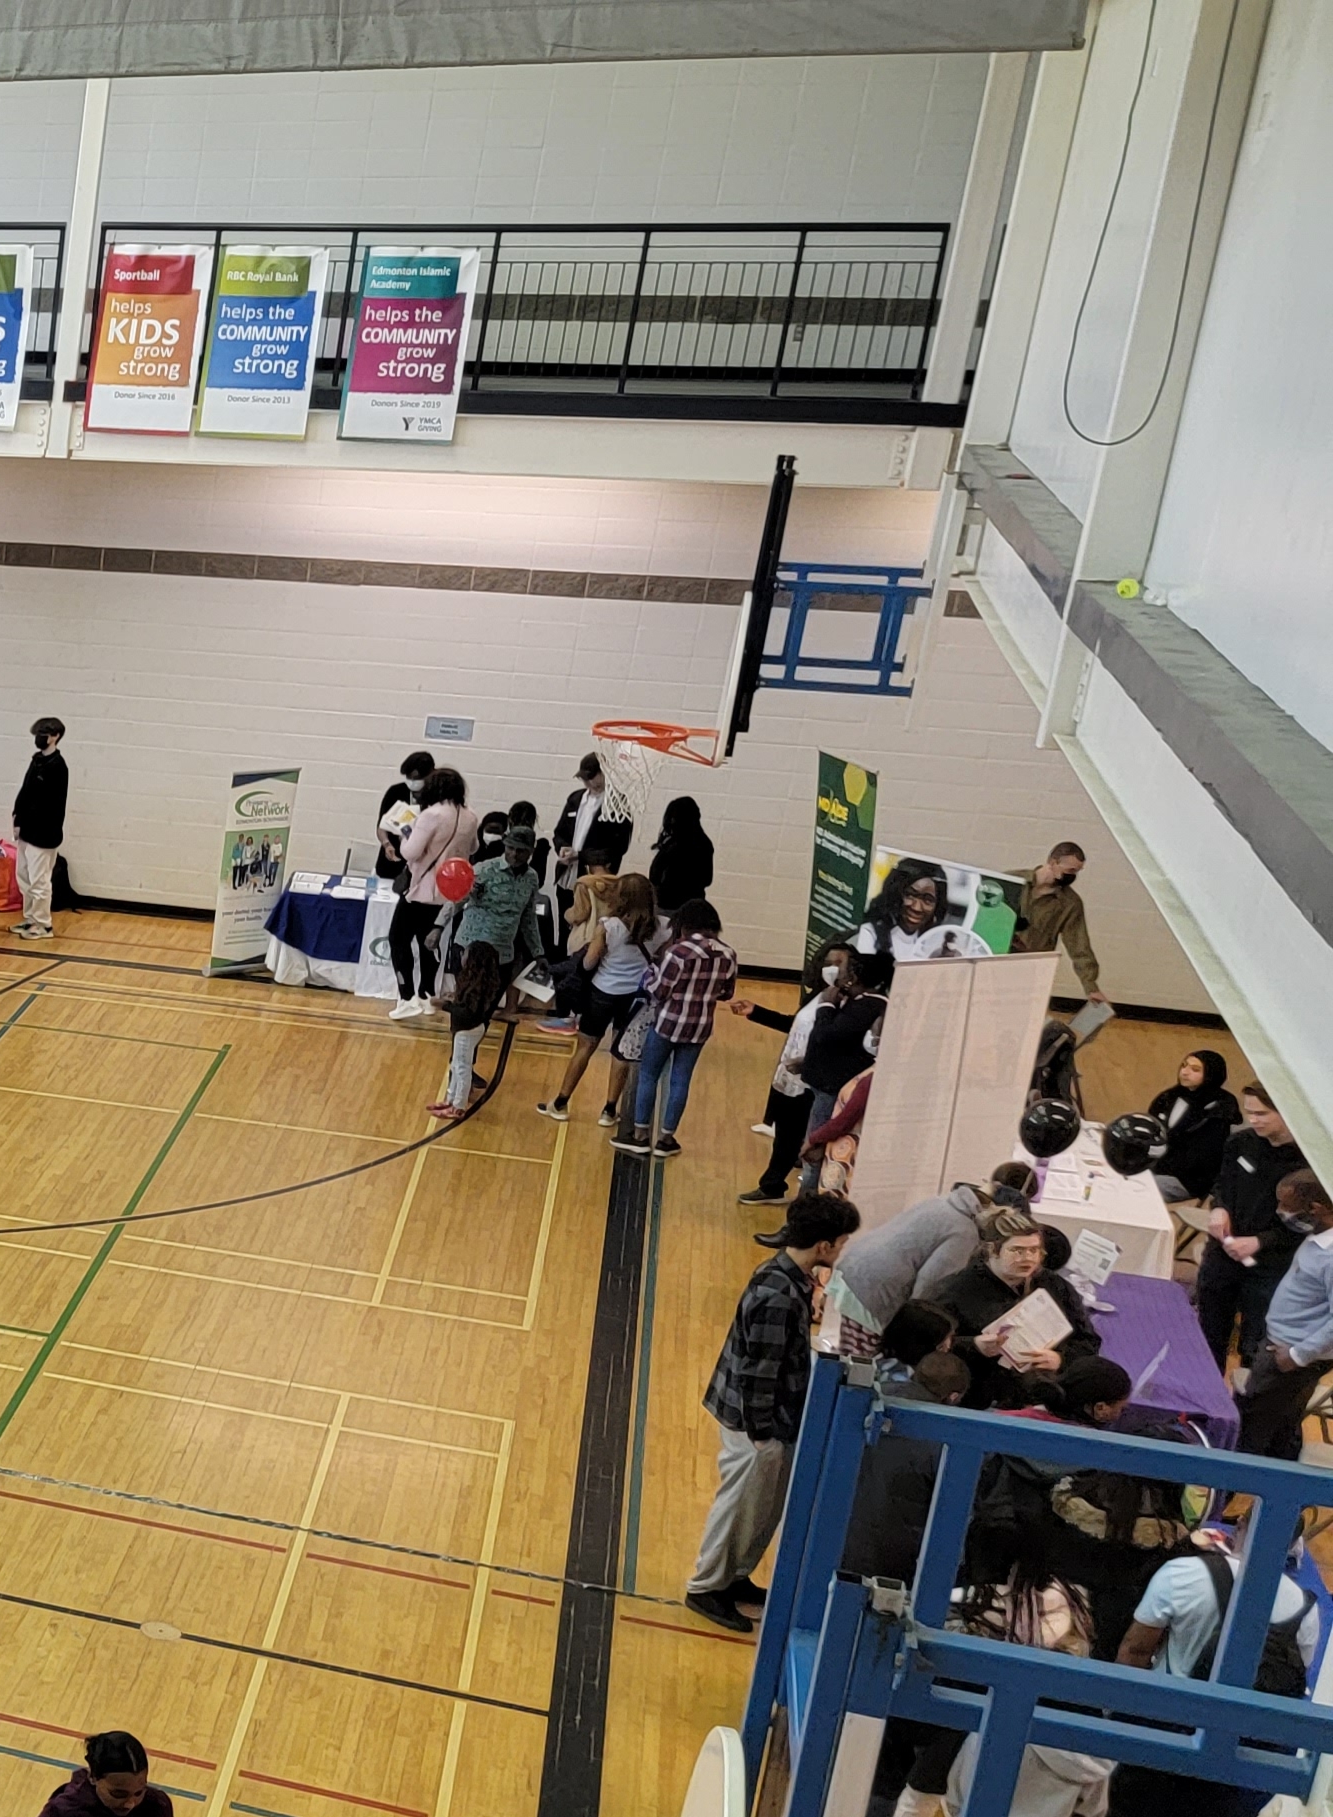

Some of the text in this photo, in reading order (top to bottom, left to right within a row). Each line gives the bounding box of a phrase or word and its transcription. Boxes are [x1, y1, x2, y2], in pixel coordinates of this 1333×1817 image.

[114, 267, 159, 282] Sportball
[227, 269, 298, 282] RBC Royal Bank
[372, 265, 450, 277] Edmonton Islamic
[370, 279, 410, 290] Academy
[111, 297, 151, 314] helps
[221, 303, 294, 320] helps the
[366, 305, 442, 321] helps the
[108, 317, 180, 344] KIDS
[218, 325, 308, 340] COMMUNITY
[362, 327, 456, 344] COMMUNITY
[134, 343, 173, 358] grow
[252, 341, 289, 355] grow
[397, 344, 436, 358] grow
[119, 358, 180, 379] strong
[234, 355, 298, 377] strong
[378, 360, 446, 381] strong
[228, 394, 247, 402] Donor
[371, 398, 397, 406] Donors
